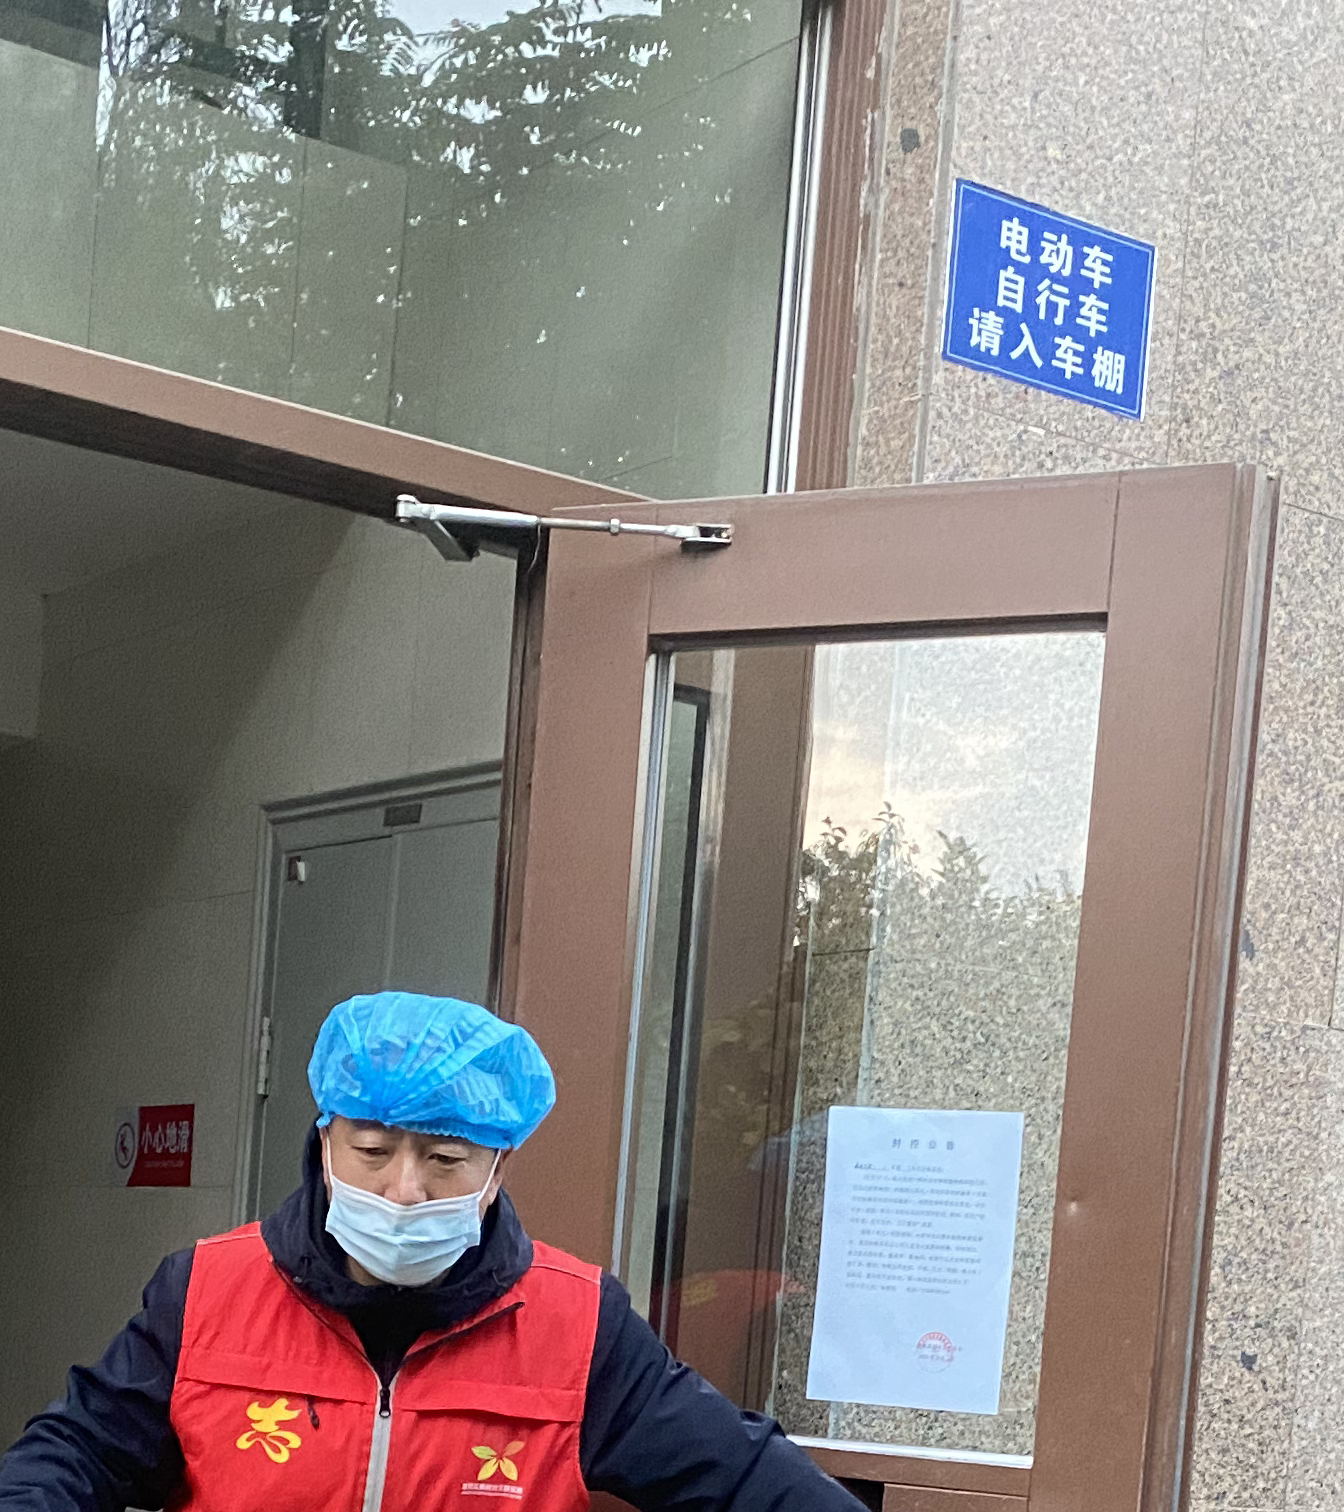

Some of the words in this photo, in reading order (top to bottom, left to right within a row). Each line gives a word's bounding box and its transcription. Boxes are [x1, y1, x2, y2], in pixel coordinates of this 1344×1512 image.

[1000, 217, 1114, 289] 电动车
[997, 266, 1110, 337] 自行车
[968, 307, 1126, 395] 请入车棚
